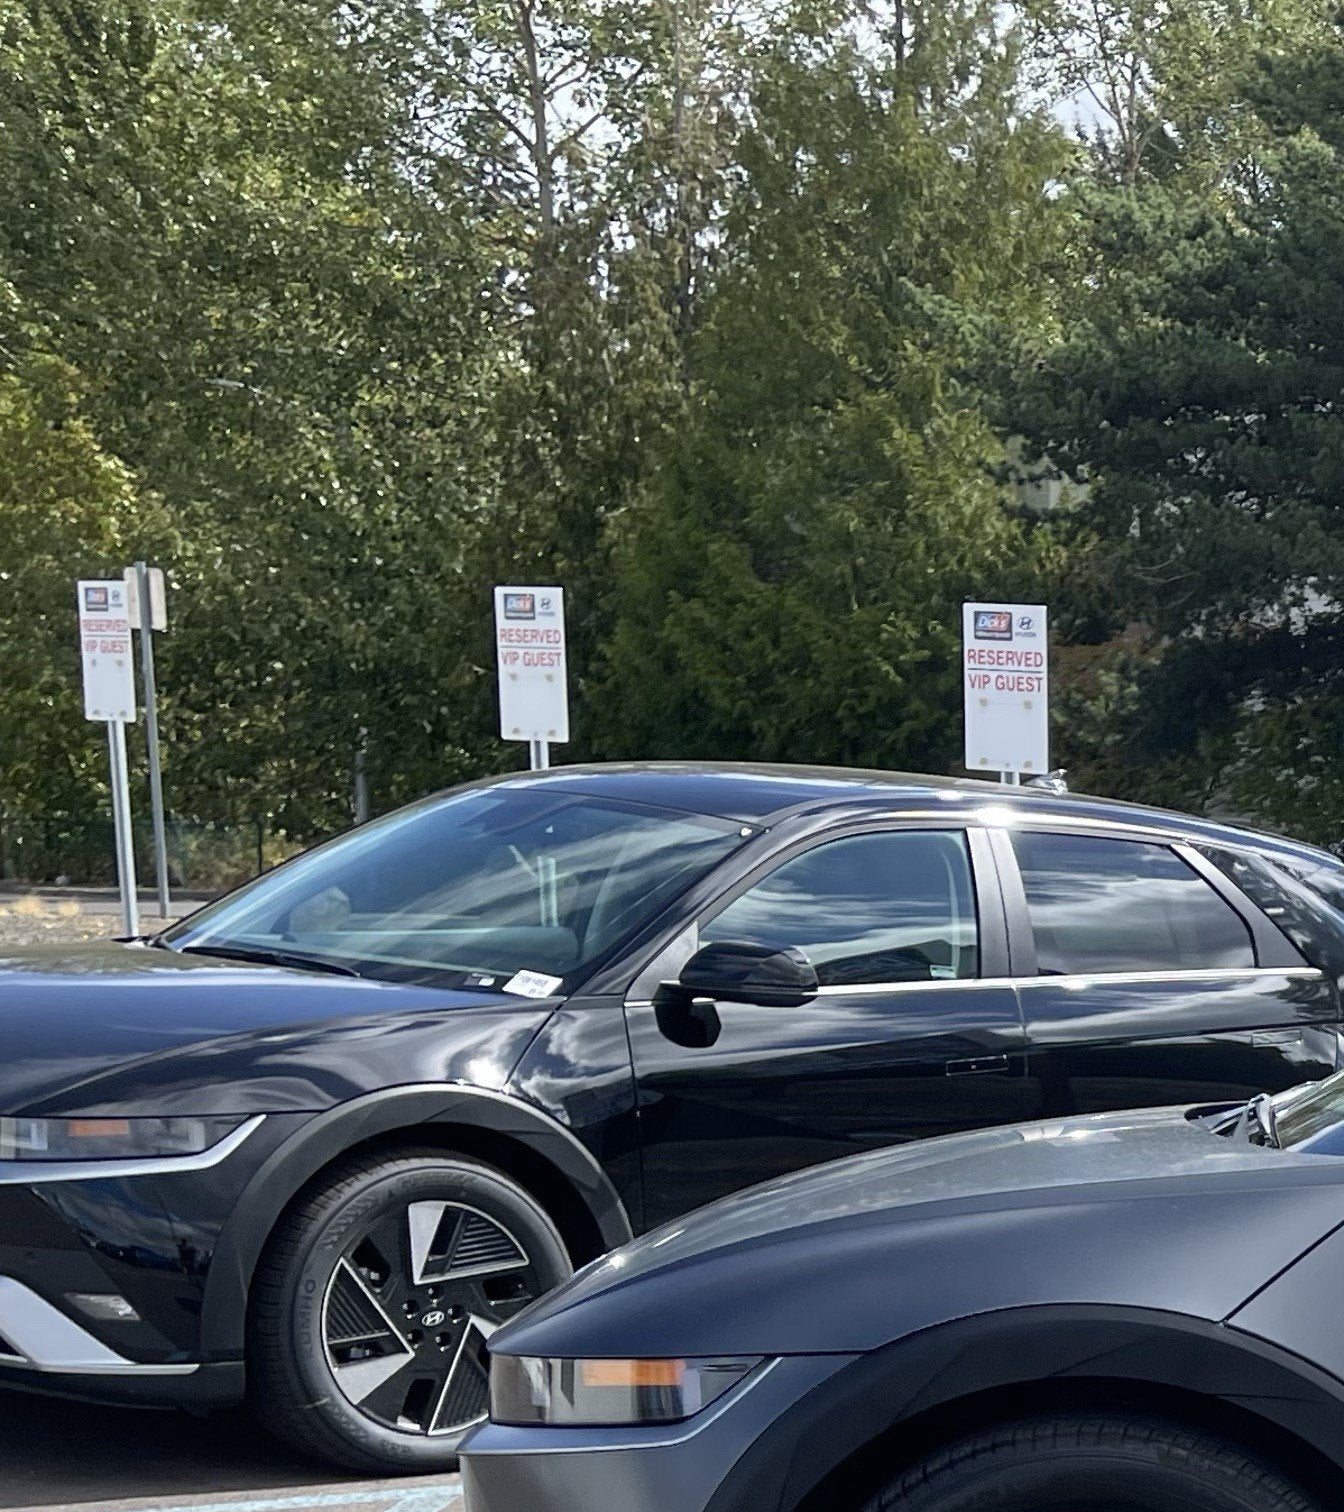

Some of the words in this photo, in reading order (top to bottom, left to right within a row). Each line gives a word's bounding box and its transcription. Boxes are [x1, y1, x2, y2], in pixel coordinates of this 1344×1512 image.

[967, 648, 1044, 668] RESERVED
[968, 673, 991, 690] VIP
[995, 674, 1044, 693] GUEST
